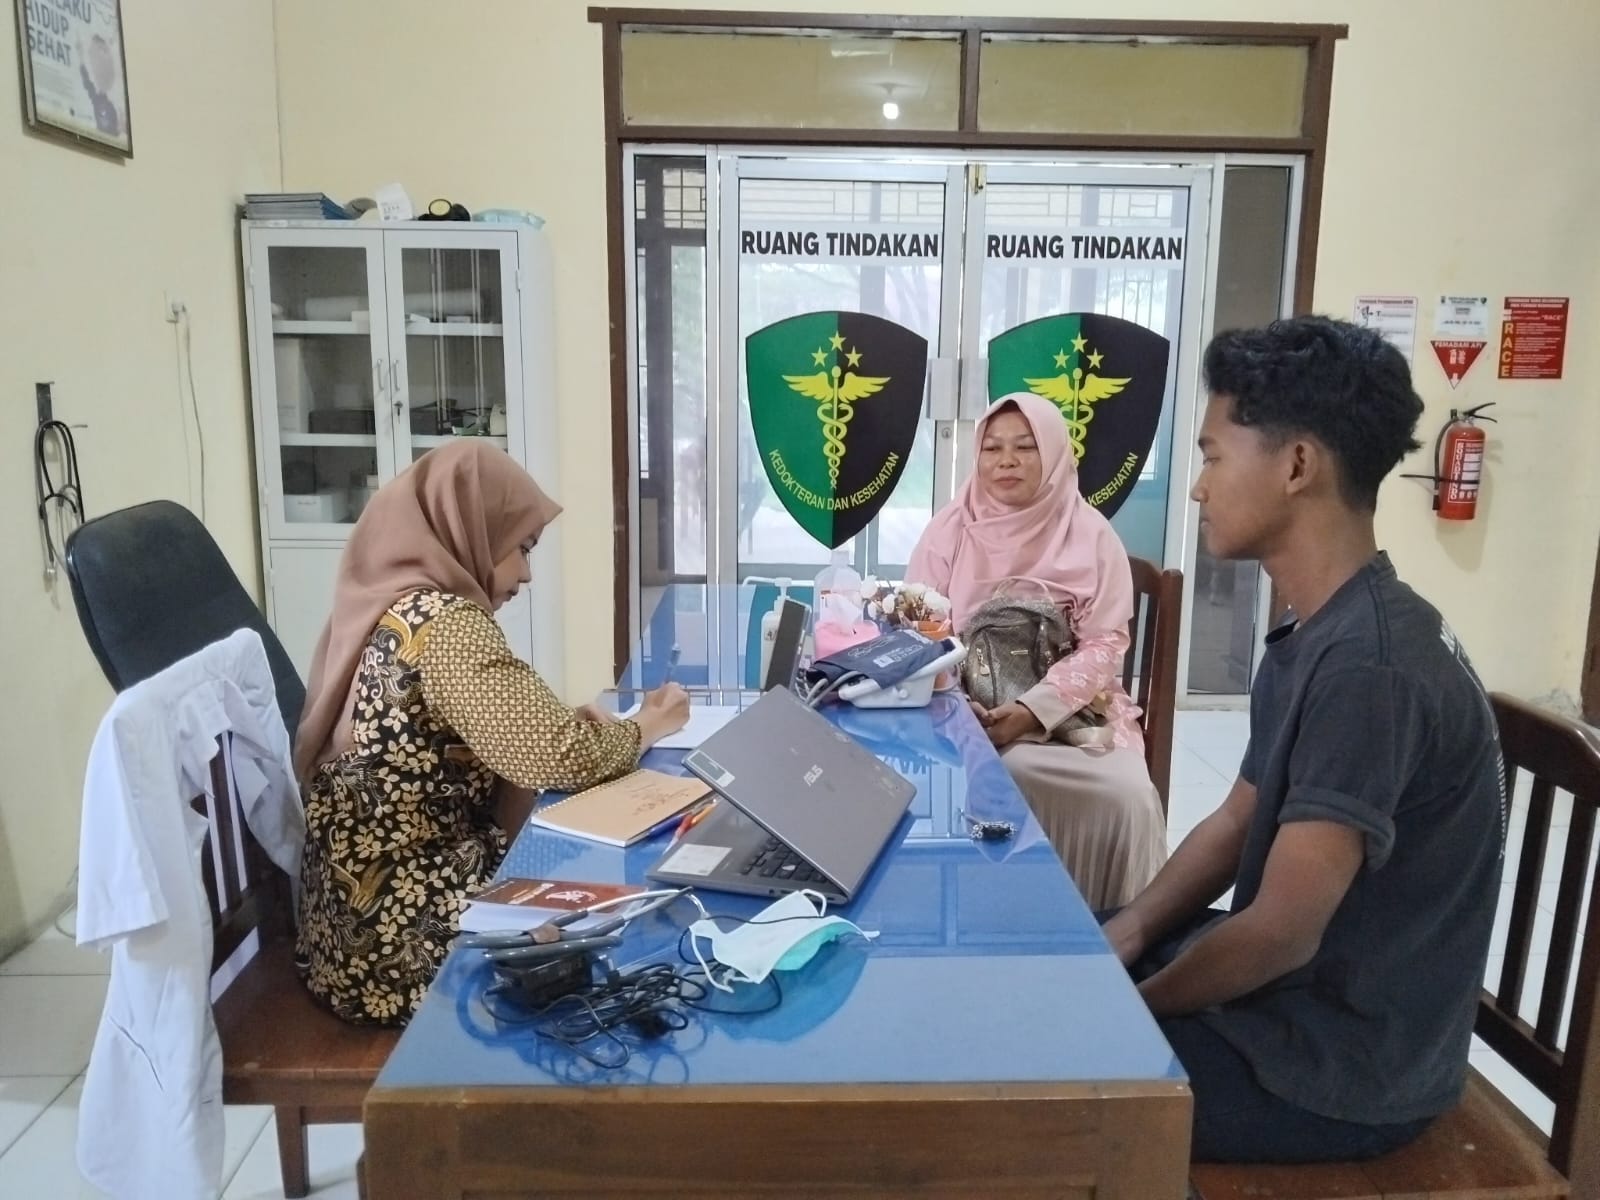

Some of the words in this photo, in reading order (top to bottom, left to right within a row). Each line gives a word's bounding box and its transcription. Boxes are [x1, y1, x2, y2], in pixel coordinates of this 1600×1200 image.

[28, 24, 71, 66] SEHAT
[741, 230, 819, 256] RUANG
[826, 232, 939, 257] TINDAKAN
[987, 234, 1064, 259] RUANG
[1071, 235, 1182, 260] TINDAKAN
[769, 449, 825, 510] KEDOKTERAN
[827, 498, 849, 511] DAN
[850, 452, 900, 508] KESEHATAN
[1087, 452, 1138, 506] KESEHATAN
